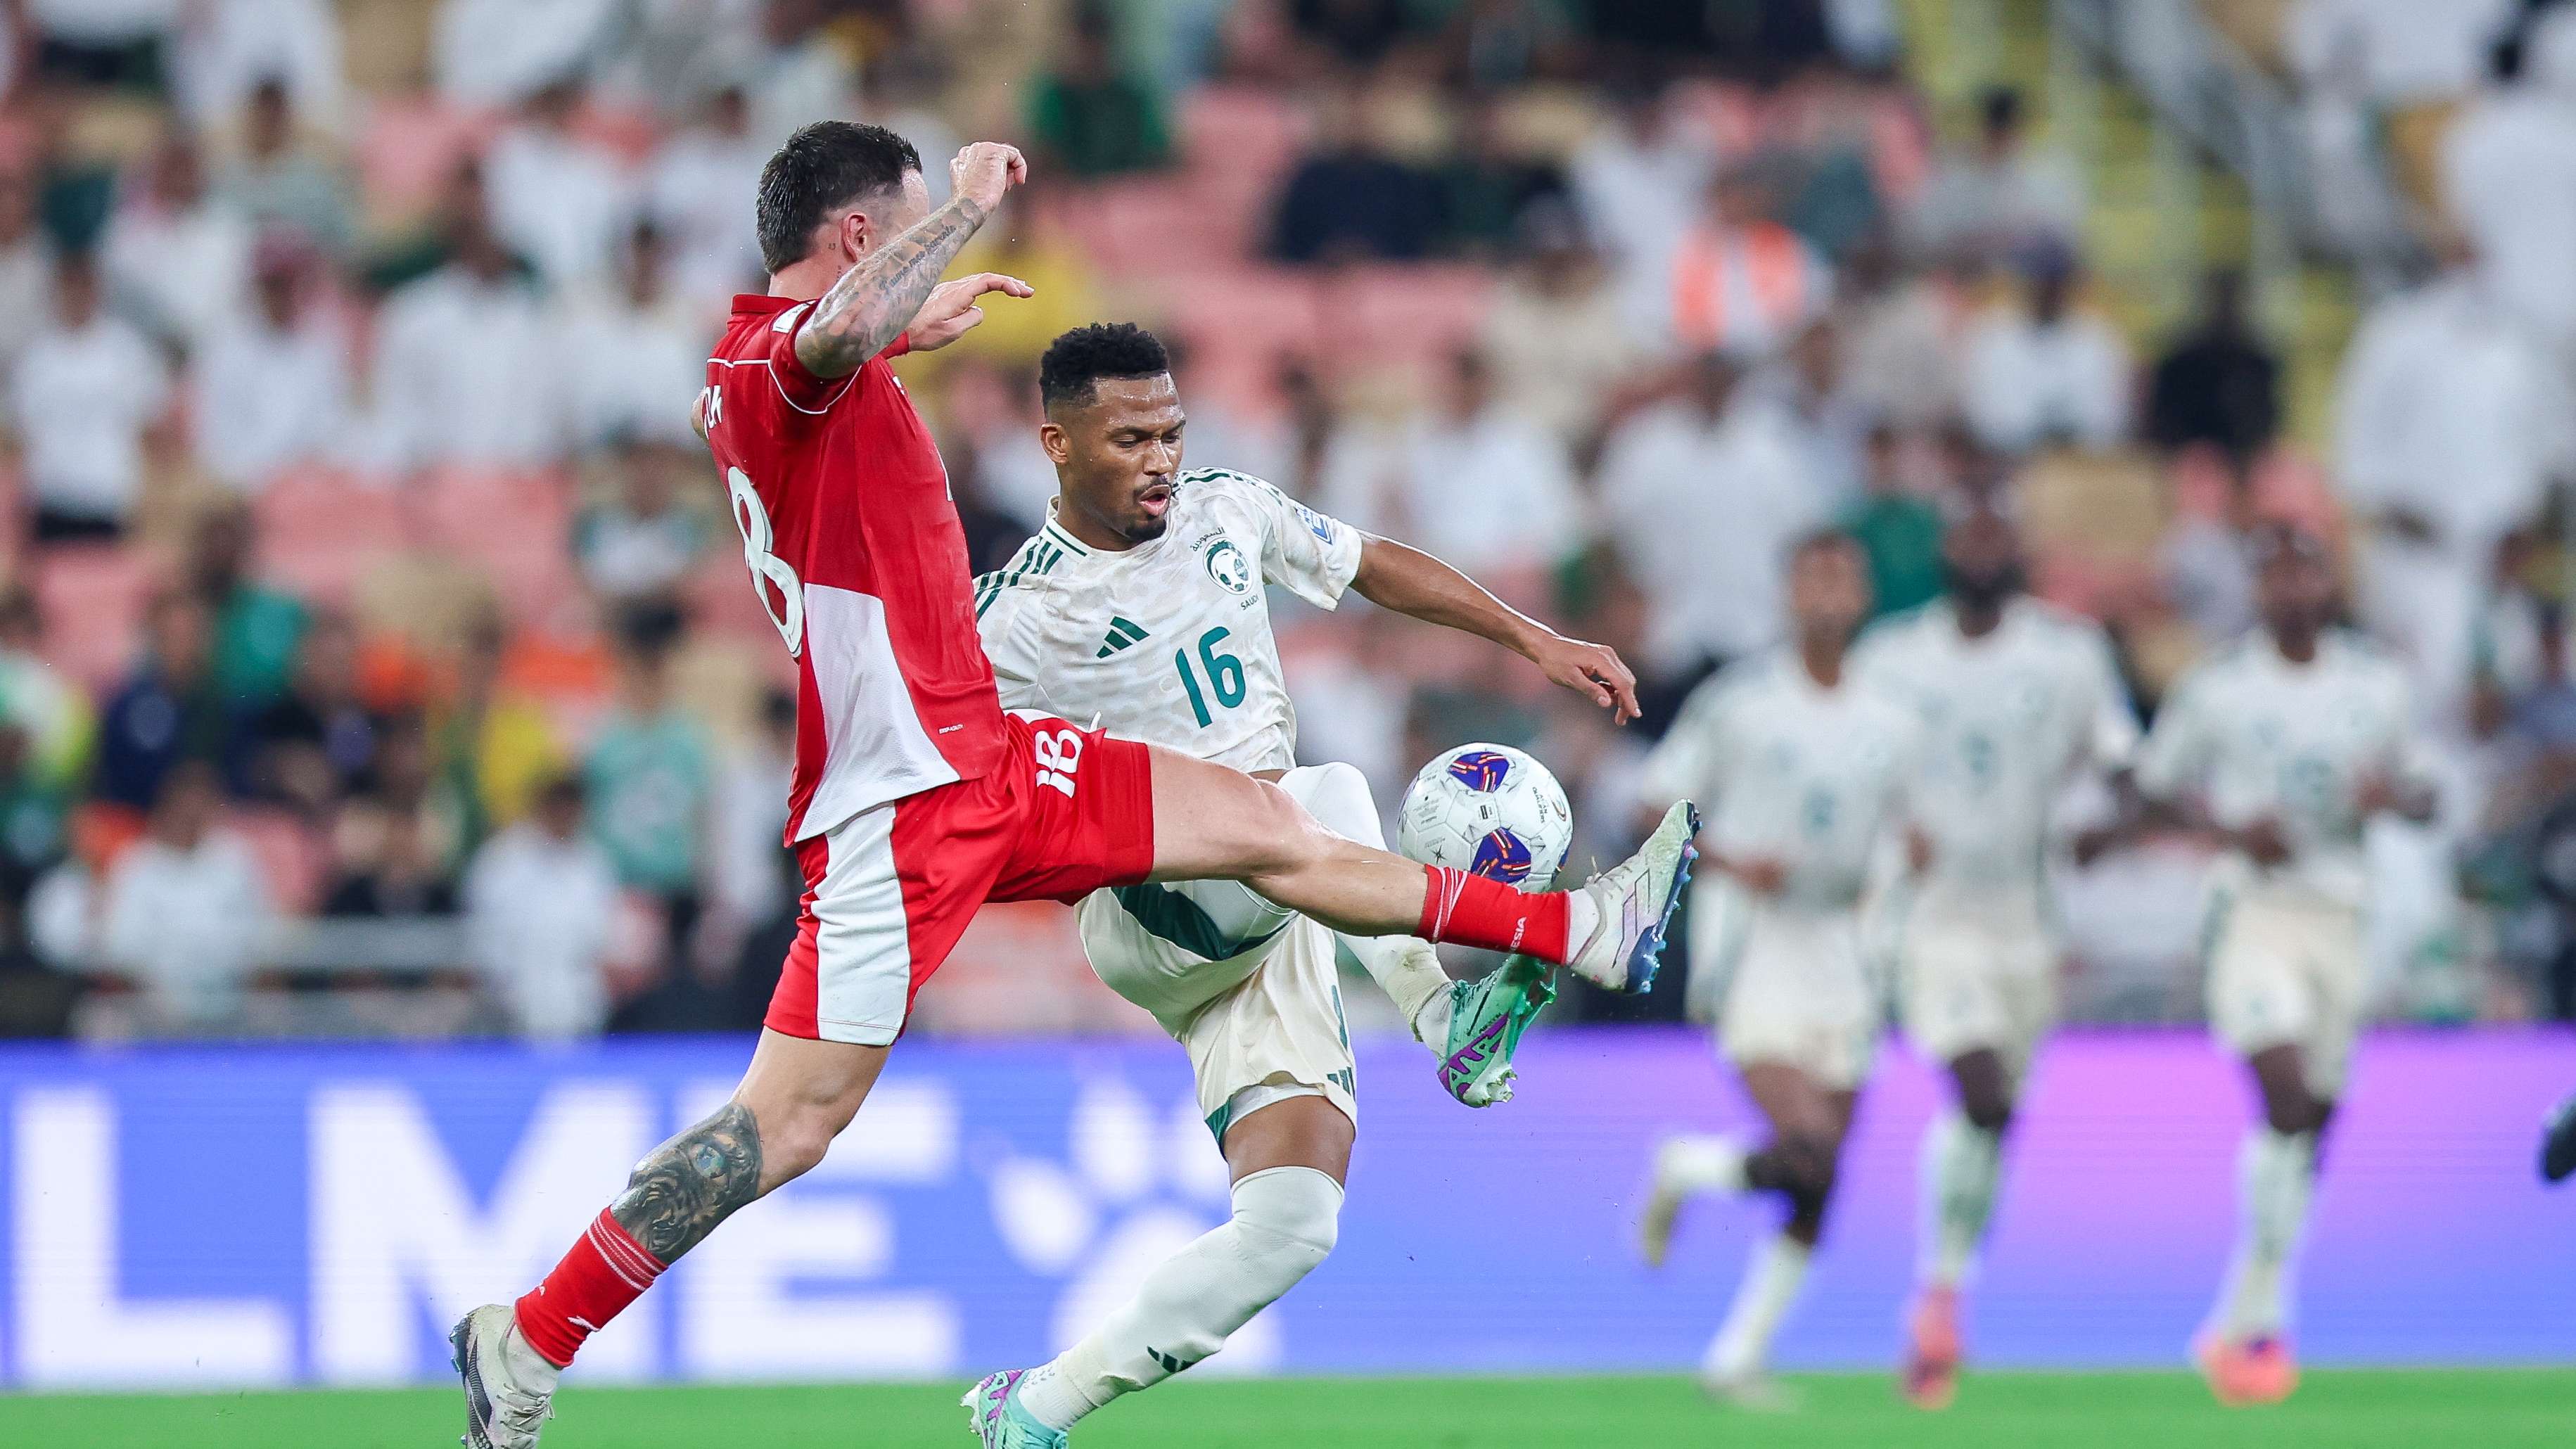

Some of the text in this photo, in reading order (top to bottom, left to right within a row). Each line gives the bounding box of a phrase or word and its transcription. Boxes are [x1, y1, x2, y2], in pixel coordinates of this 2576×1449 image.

[1240, 594, 1259, 611] SAUDI
[1175, 627, 1246, 728] 16
[1034, 729, 1083, 798] 18
[10, 1080, 964, 1386] LME
